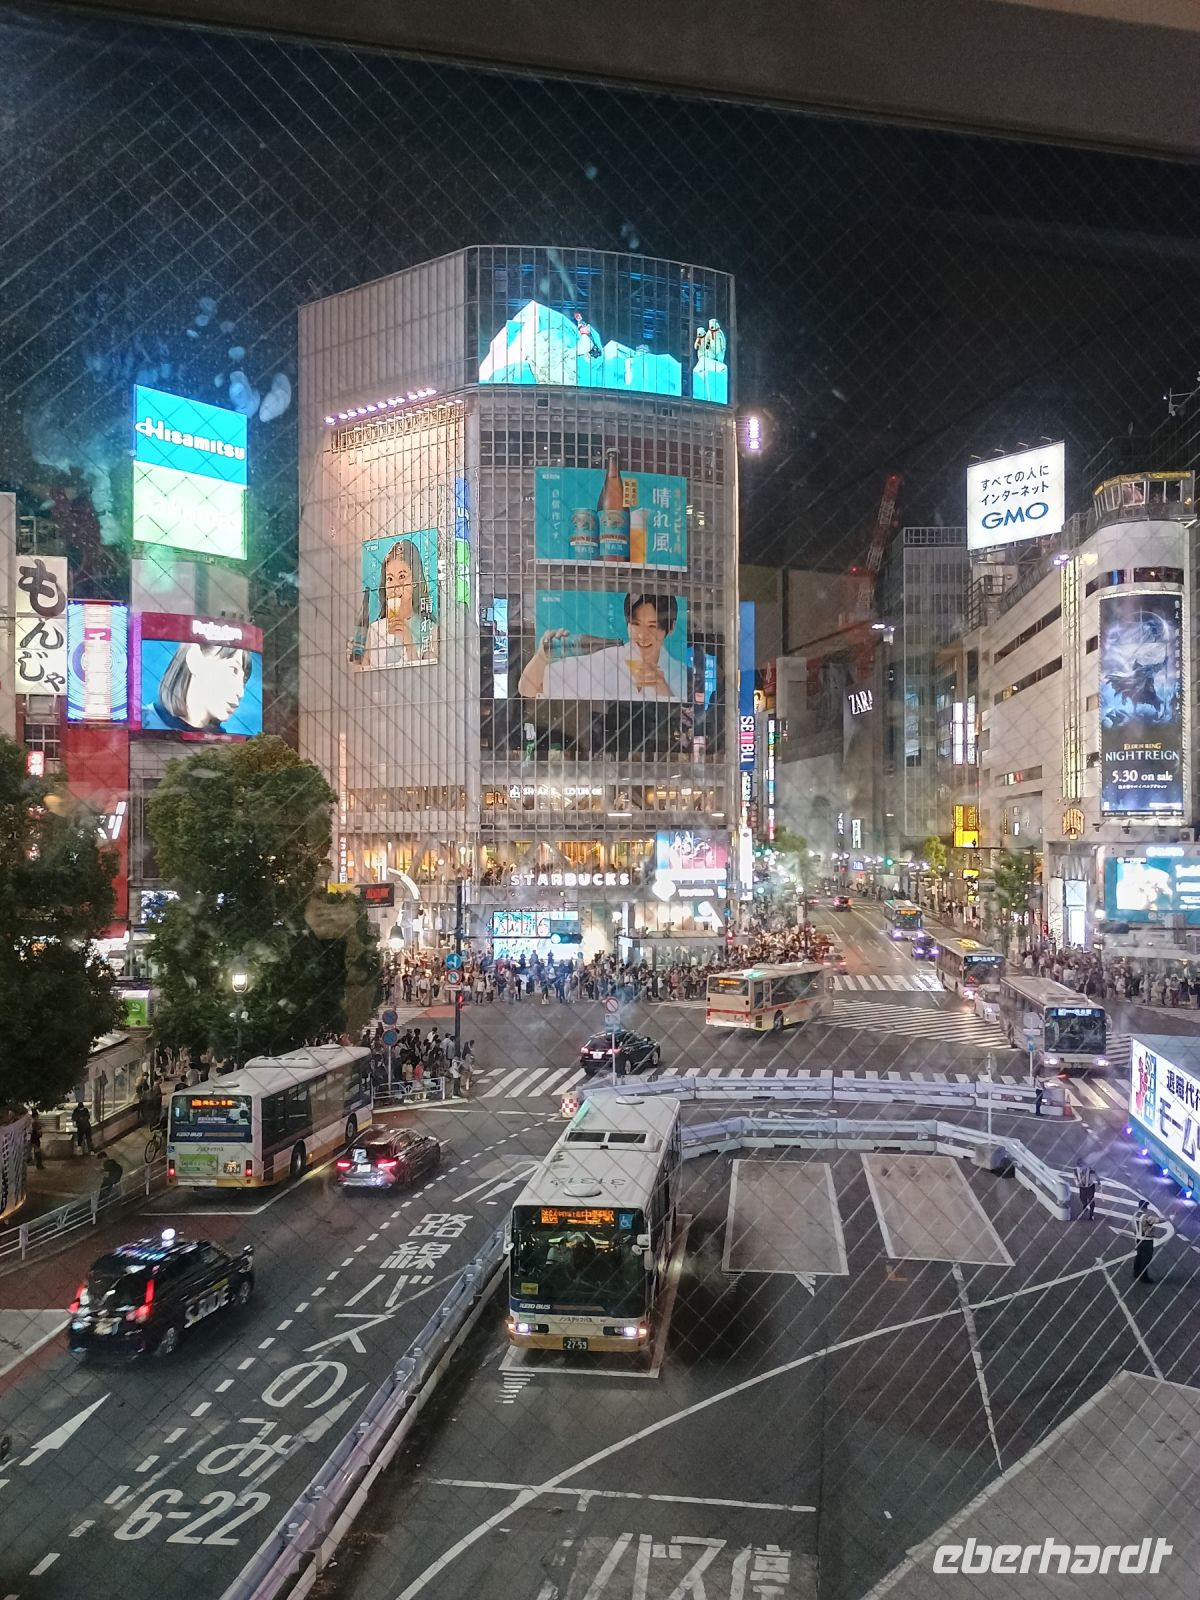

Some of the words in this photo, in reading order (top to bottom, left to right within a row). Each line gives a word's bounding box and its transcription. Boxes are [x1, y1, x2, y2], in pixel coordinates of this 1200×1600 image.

[135, 417, 245, 460] Hisamitsu
[981, 464, 1050, 491] すべての人に
[981, 483, 1050, 506] インターネット
[652, 487, 673, 553] 晴れ風
[981, 502, 1049, 530] GMO
[18, 558, 66, 692] もんじゃ
[848, 689, 873, 715] ZARA
[1105, 750, 1180, 762] NIGHTREIGN
[1112, 770, 1138, 783] 5.30
[1141, 773, 1154, 781] on
[1157, 771, 1173, 781] sale
[510, 872, 630, 887] STARBUCKS
[114, 1489, 271, 1546] 6-22
